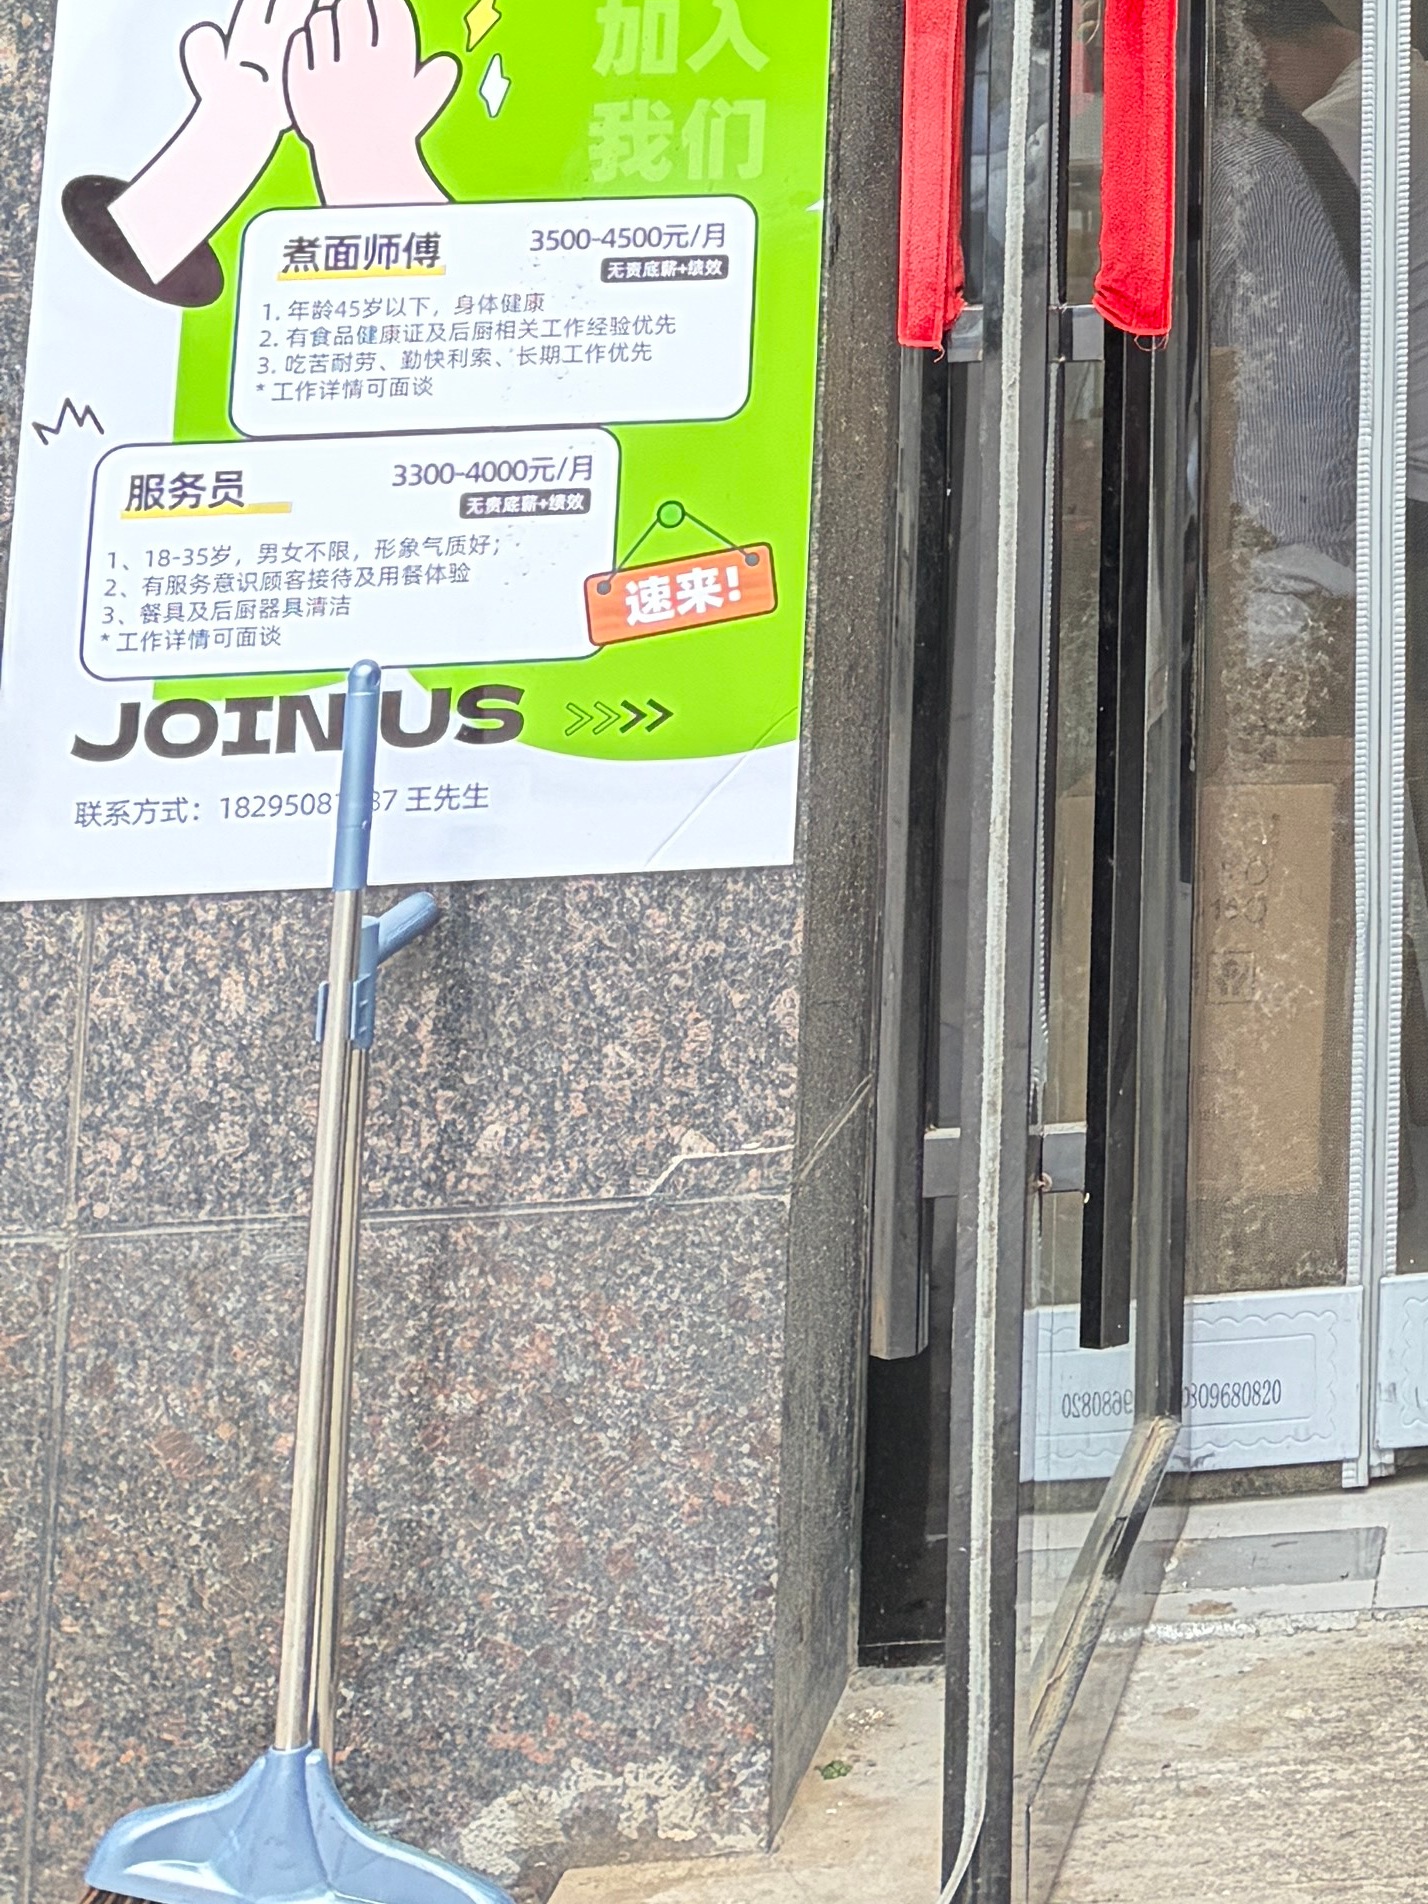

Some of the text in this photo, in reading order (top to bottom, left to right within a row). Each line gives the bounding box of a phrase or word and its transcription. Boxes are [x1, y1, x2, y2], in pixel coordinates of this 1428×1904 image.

[588, 97, 768, 184] 我们
[281, 222, 727, 274] 煮面师傅 3500-4500元/月
[287, 315, 676, 349] 有食品健康证及后厨相关工作经验优先
[285, 344, 653, 376] 吃苦耐劳、勤快利索、长期工作优先
[124, 455, 594, 512] 服务员 3300-4000元/月
[71, 684, 525, 762] JOIN US
[405, 782, 489, 811] 王先生
